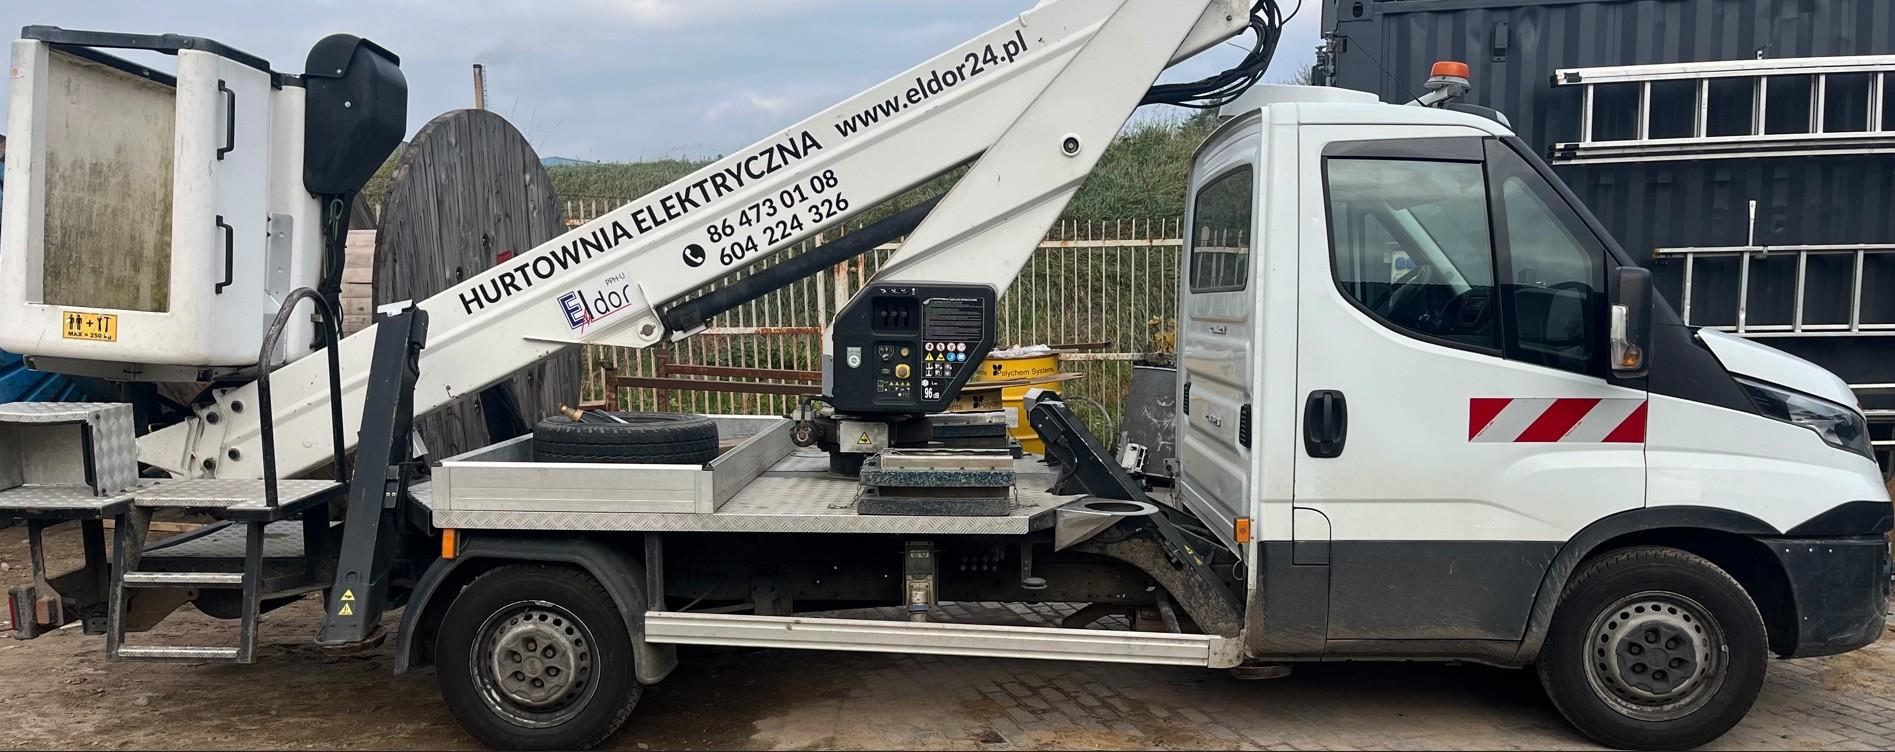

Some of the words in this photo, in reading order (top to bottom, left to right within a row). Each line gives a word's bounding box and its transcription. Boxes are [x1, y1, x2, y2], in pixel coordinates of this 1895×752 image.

[459, 221, 633, 315] HURTOWNIA
[631, 131, 822, 234] ELEKTRYCZNA
[835, 30, 1028, 137] www.eldor24.pl
[706, 220, 735, 244] 86
[738, 198, 777, 227] 473
[780, 183, 809, 208] 01
[809, 169, 839, 194] 08
[719, 236, 759, 266] 604
[763, 213, 804, 246] 224
[808, 192, 849, 224] 326
[604, 271, 626, 286] PPH-U
[557, 284, 630, 331] Eldor
[924, 387, 933, 399] 96
[997, 369, 1030, 377] Polychem
[1031, 366, 1055, 375] Systems
